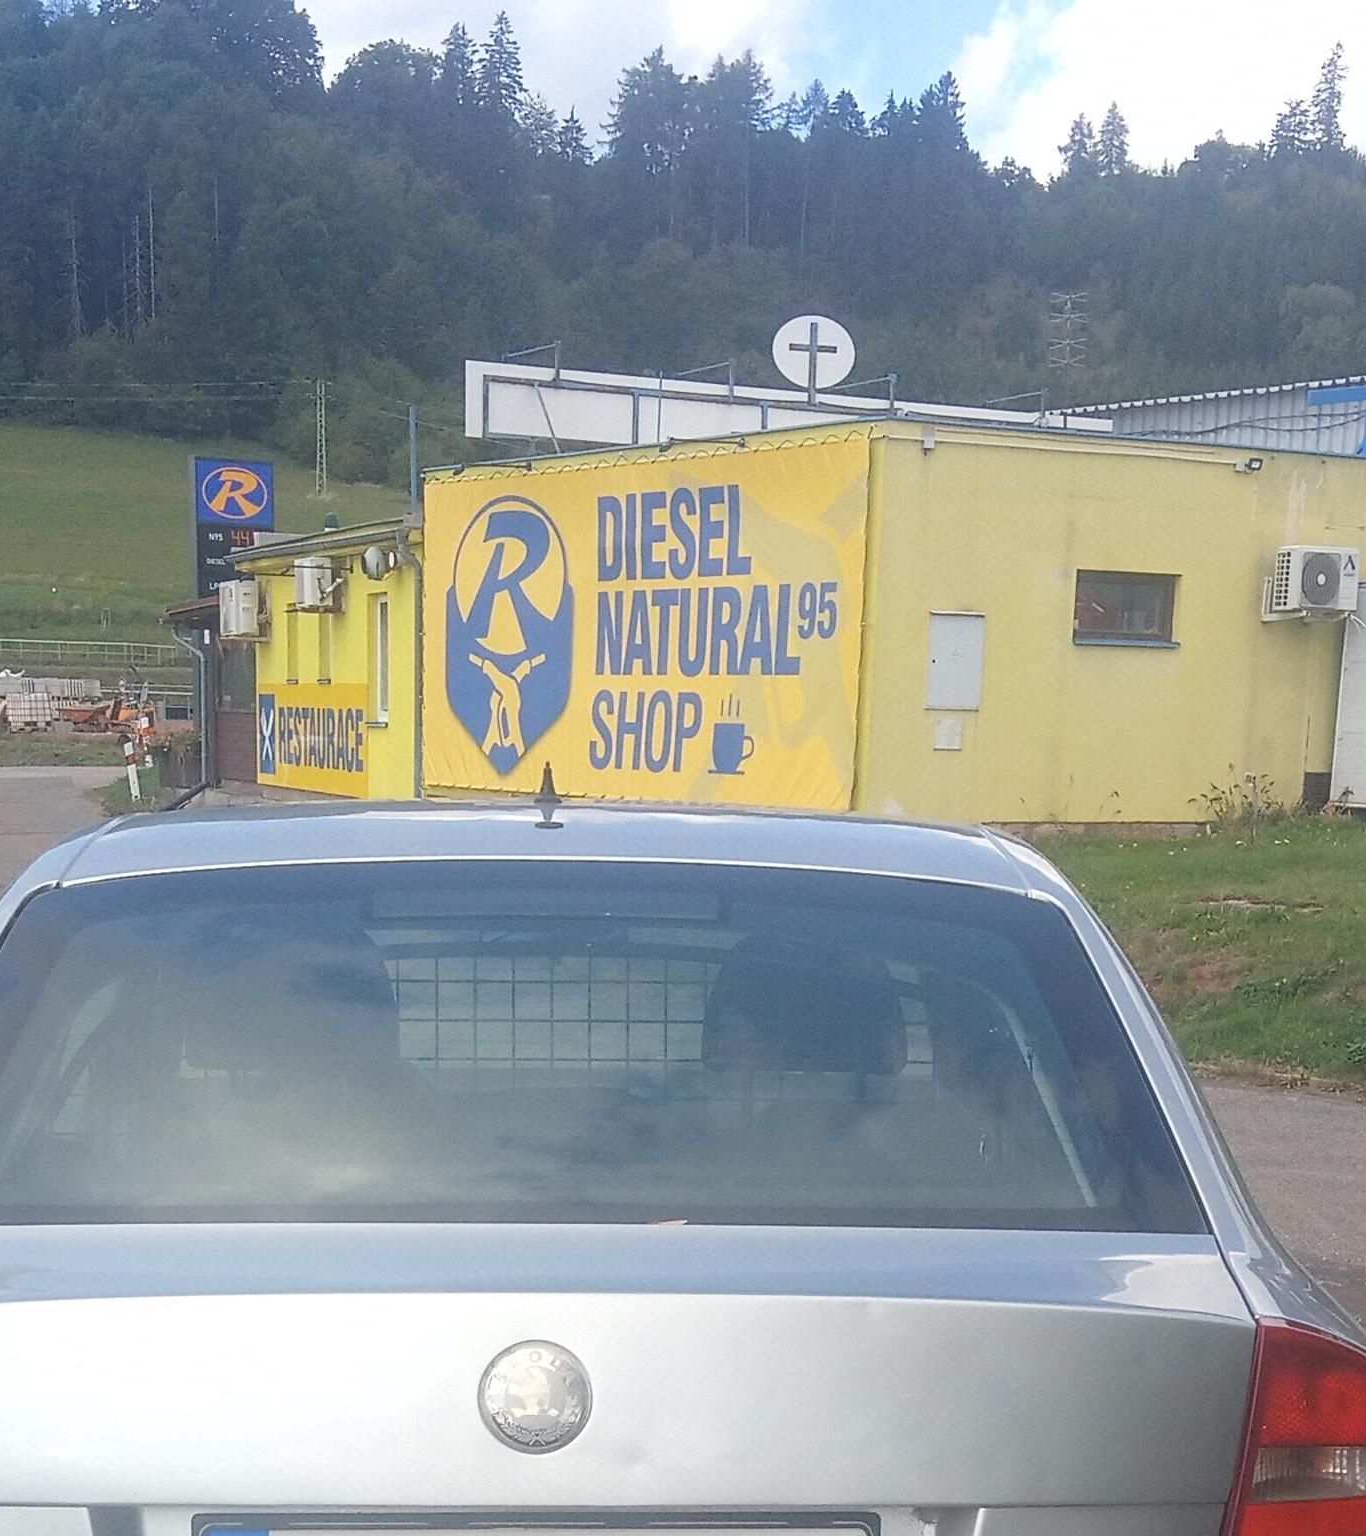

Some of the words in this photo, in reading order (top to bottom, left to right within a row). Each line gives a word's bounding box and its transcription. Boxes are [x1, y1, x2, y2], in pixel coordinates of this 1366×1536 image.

[209, 471, 260, 517] R
[206, 557, 227, 566] DIESEL
[209, 533, 223, 541] N95
[596, 484, 752, 582] DIESEL
[594, 582, 801, 677] NATURAL
[796, 582, 838, 639] 95
[278, 706, 364, 773] RESTAURACE
[588, 689, 703, 773] SHOP
